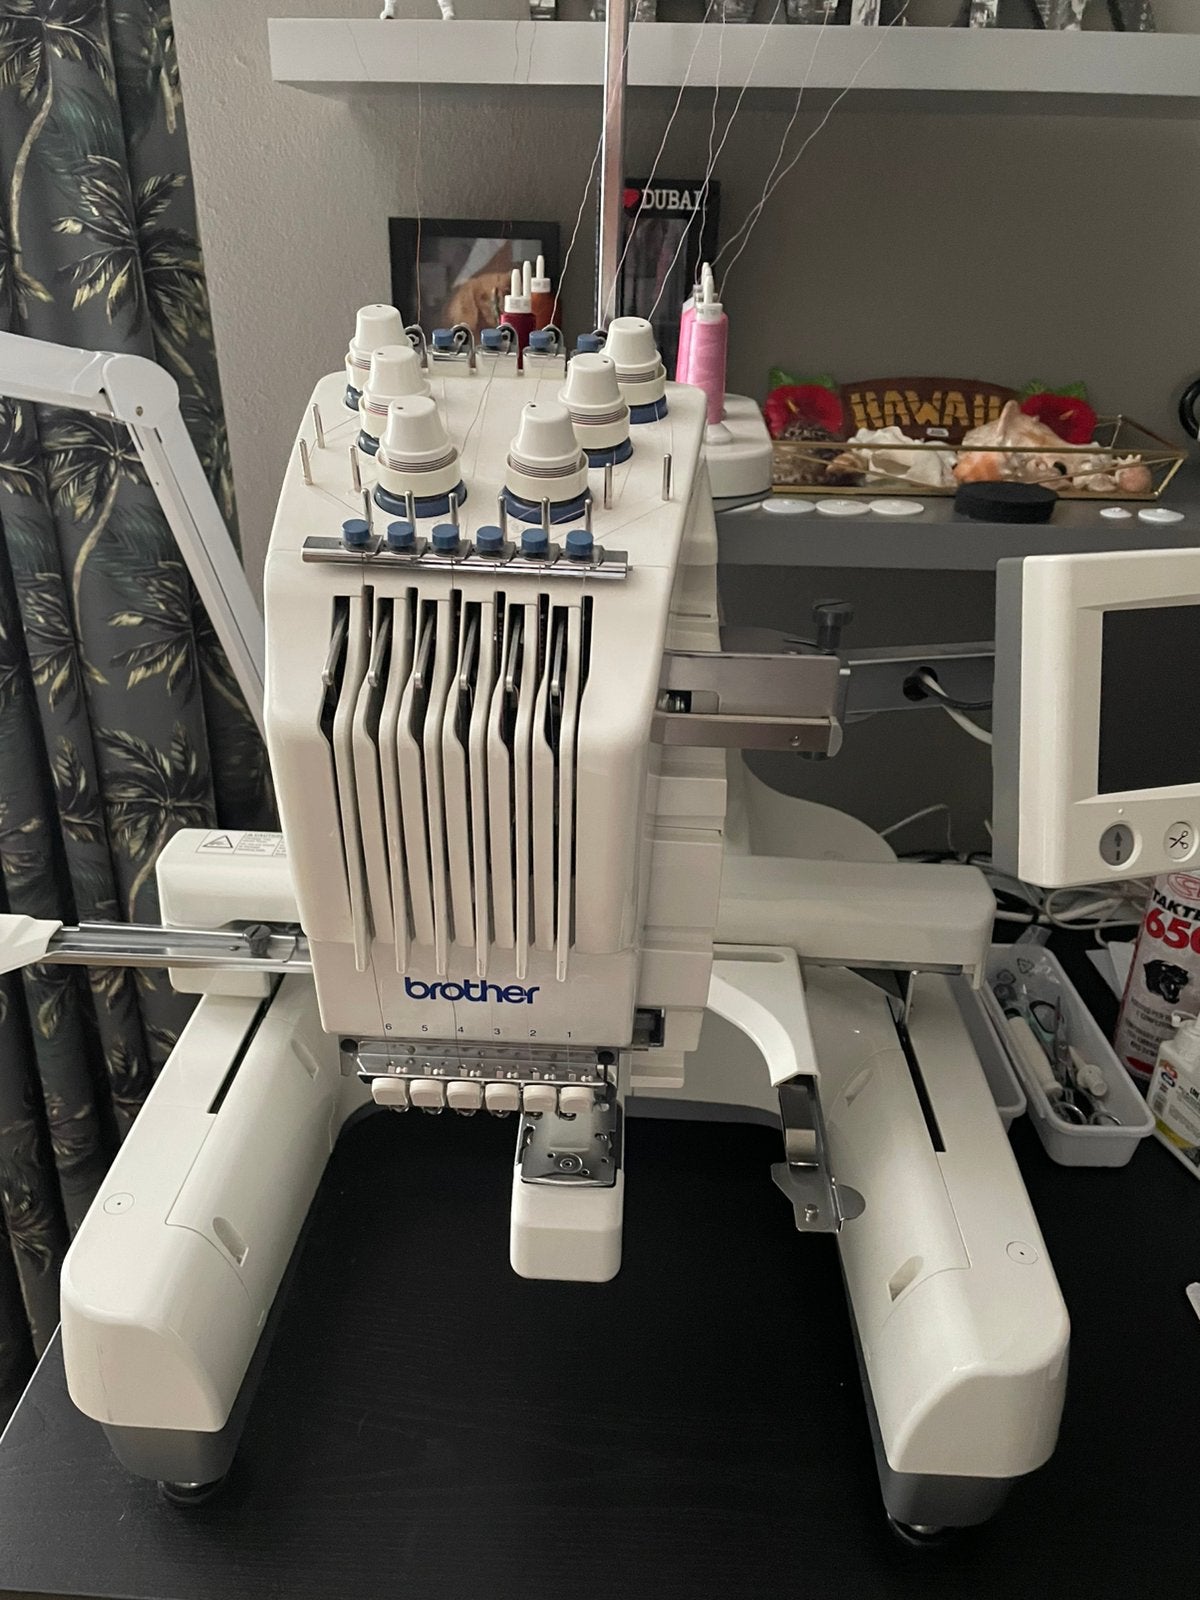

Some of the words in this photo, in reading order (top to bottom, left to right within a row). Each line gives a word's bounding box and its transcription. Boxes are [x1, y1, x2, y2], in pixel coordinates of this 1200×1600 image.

[641, 189, 702, 210] DUBAI
[851, 390, 1001, 428] HAWAII
[404, 976, 540, 1004] brother
[385, 1023, 392, 1031] 6
[421, 1024, 428, 1032] 5
[457, 1025, 465, 1033] 4
[494, 1027, 501, 1035] 3
[529, 1029, 537, 1037] 2
[566, 1030, 572, 1038] 1
